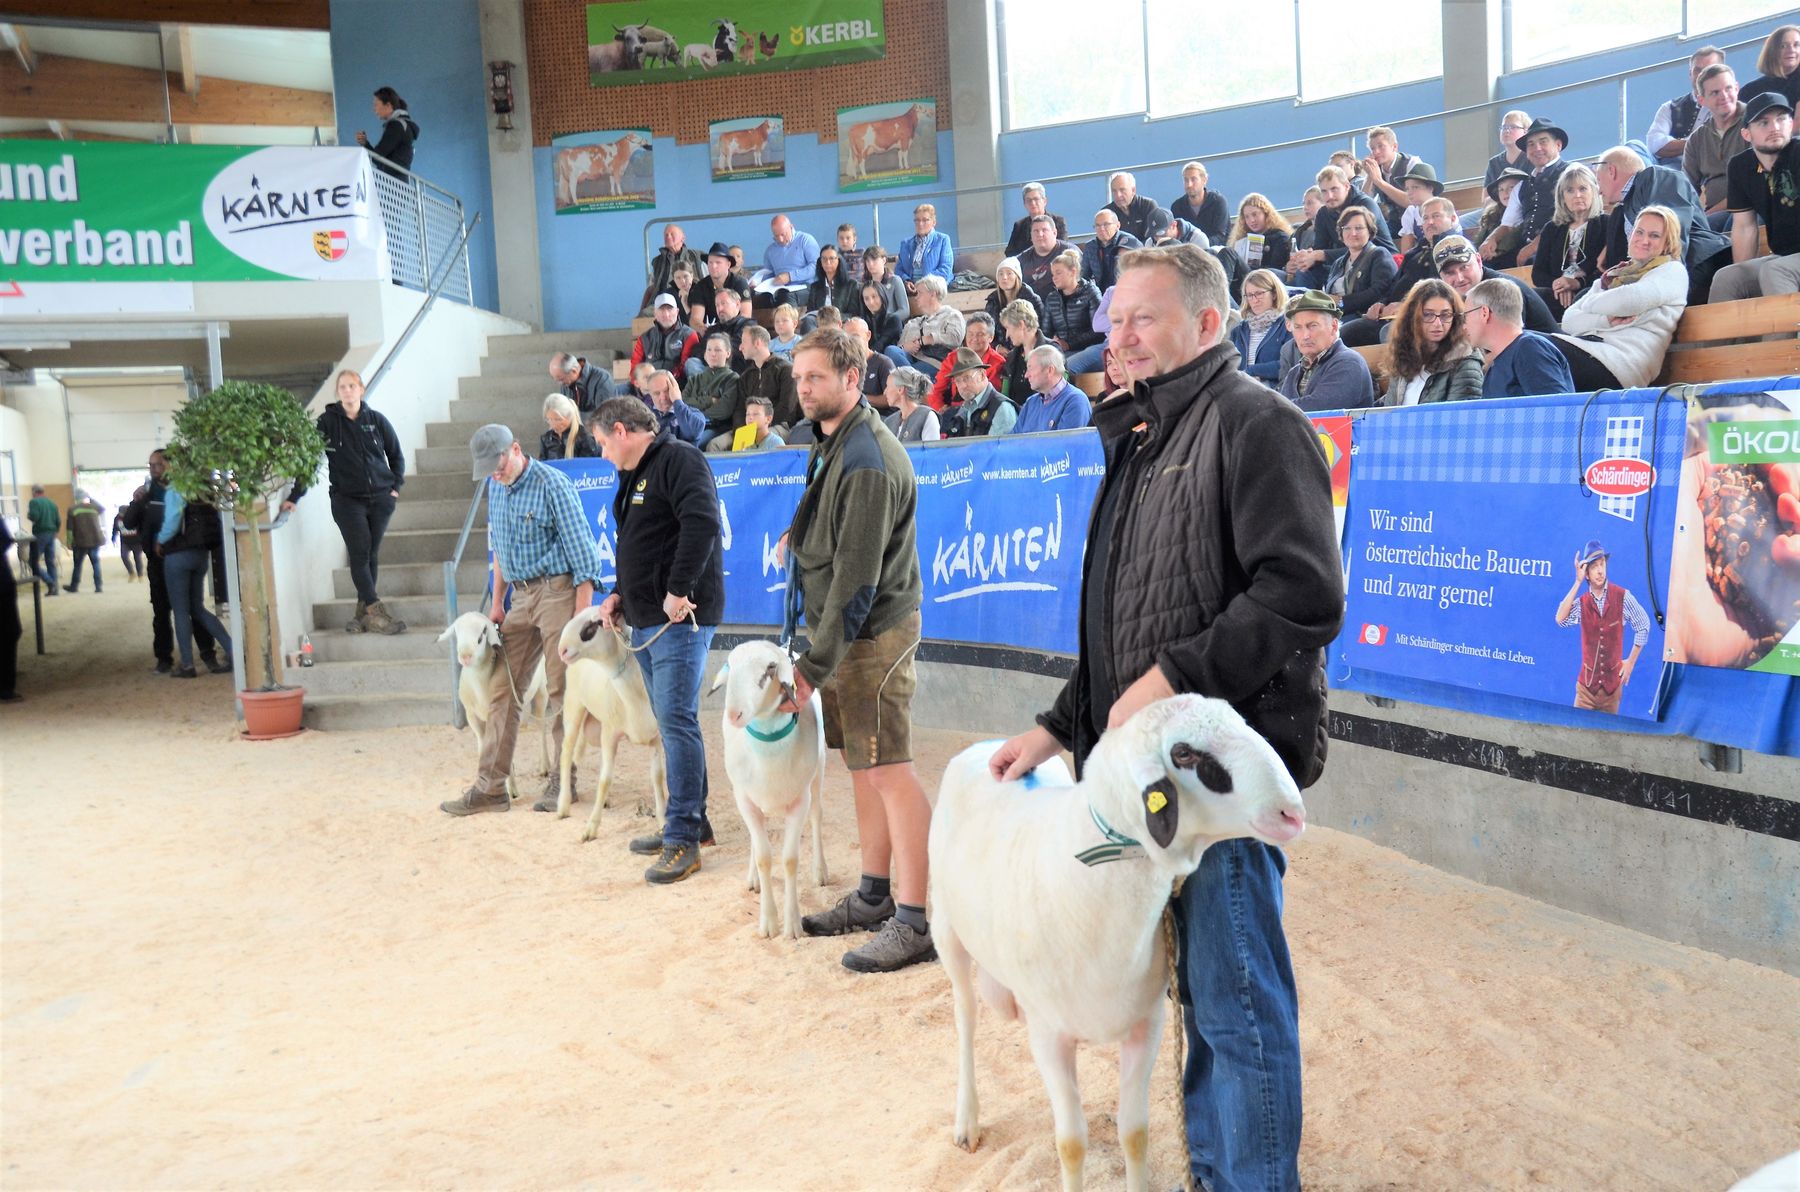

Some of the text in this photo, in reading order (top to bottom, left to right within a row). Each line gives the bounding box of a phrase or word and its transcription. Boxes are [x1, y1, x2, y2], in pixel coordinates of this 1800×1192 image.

[806, 19, 878, 45] KERBL
[982, 467, 1037, 481] www.kaernten.at
[1369, 508, 1433, 533] Wir sind
[1366, 541, 1552, 578] österreichische Bauern
[1363, 574, 1494, 610] und zwar gerne!
[1395, 633, 1408, 645] Mit
[1409, 634, 1453, 655] Schärdinger
[1454, 641, 1491, 659] schmeckt
[1492, 647, 1506, 661] das
[1508, 650, 1535, 666] Leben.
